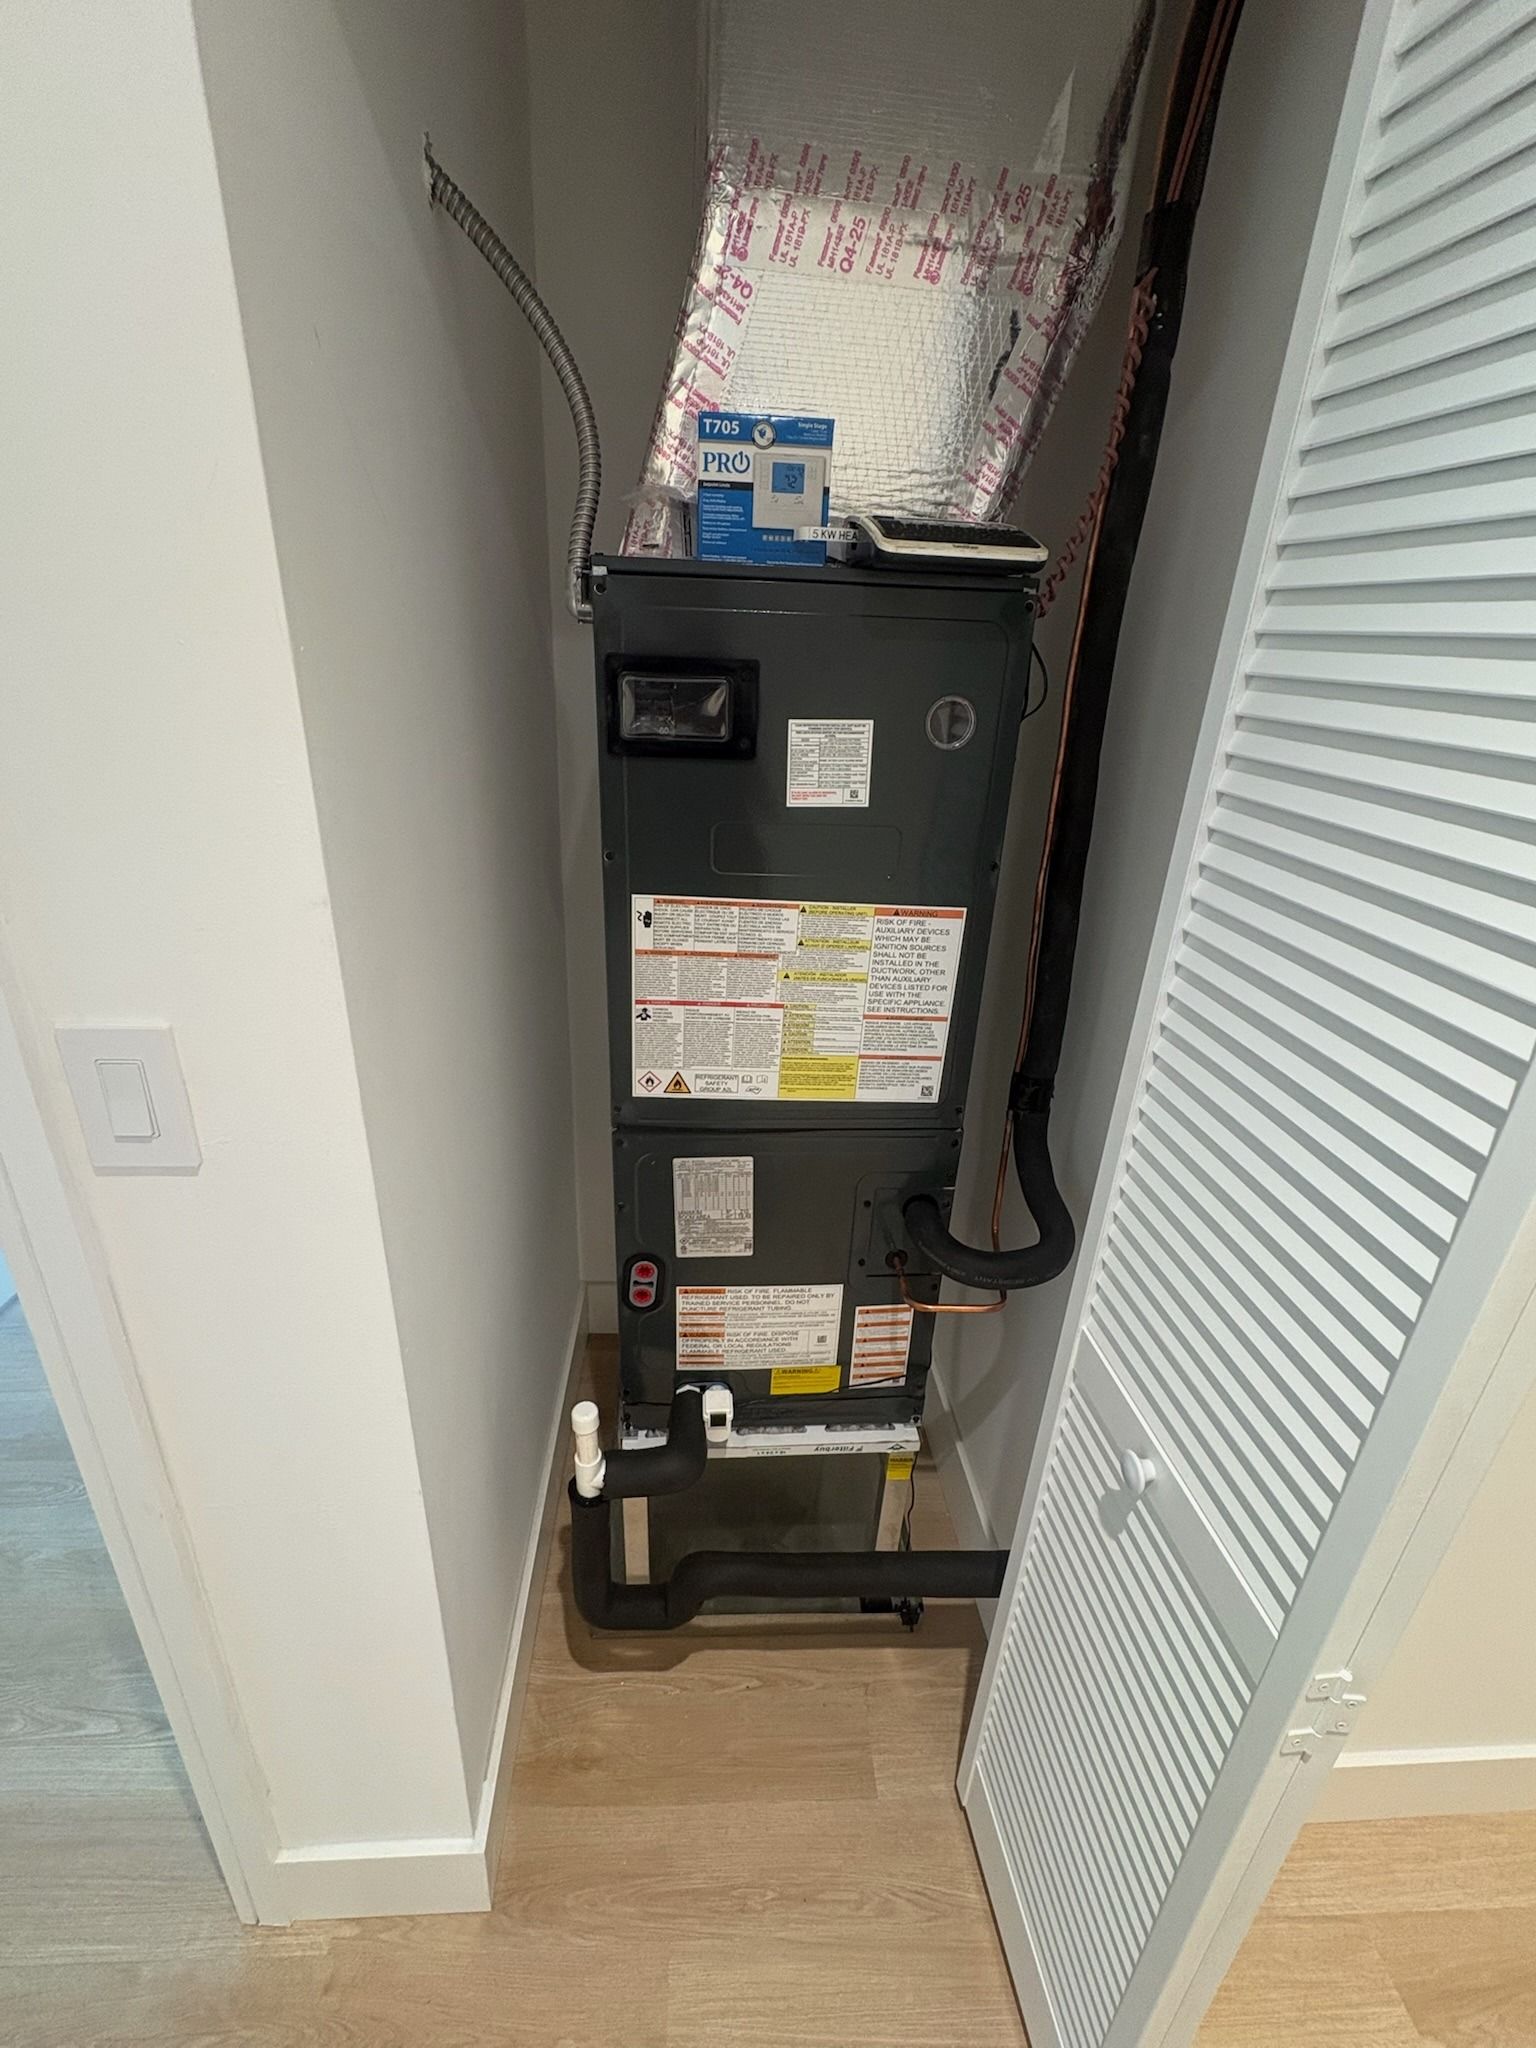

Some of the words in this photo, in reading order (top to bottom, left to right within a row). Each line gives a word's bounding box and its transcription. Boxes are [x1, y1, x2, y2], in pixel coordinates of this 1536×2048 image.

[838, 217, 867, 273] Q4-25
[703, 418, 740, 435] T705
[812, 530, 820, 540] 5
[820, 530, 838, 540] KW
[838, 530, 858, 540] HEA
